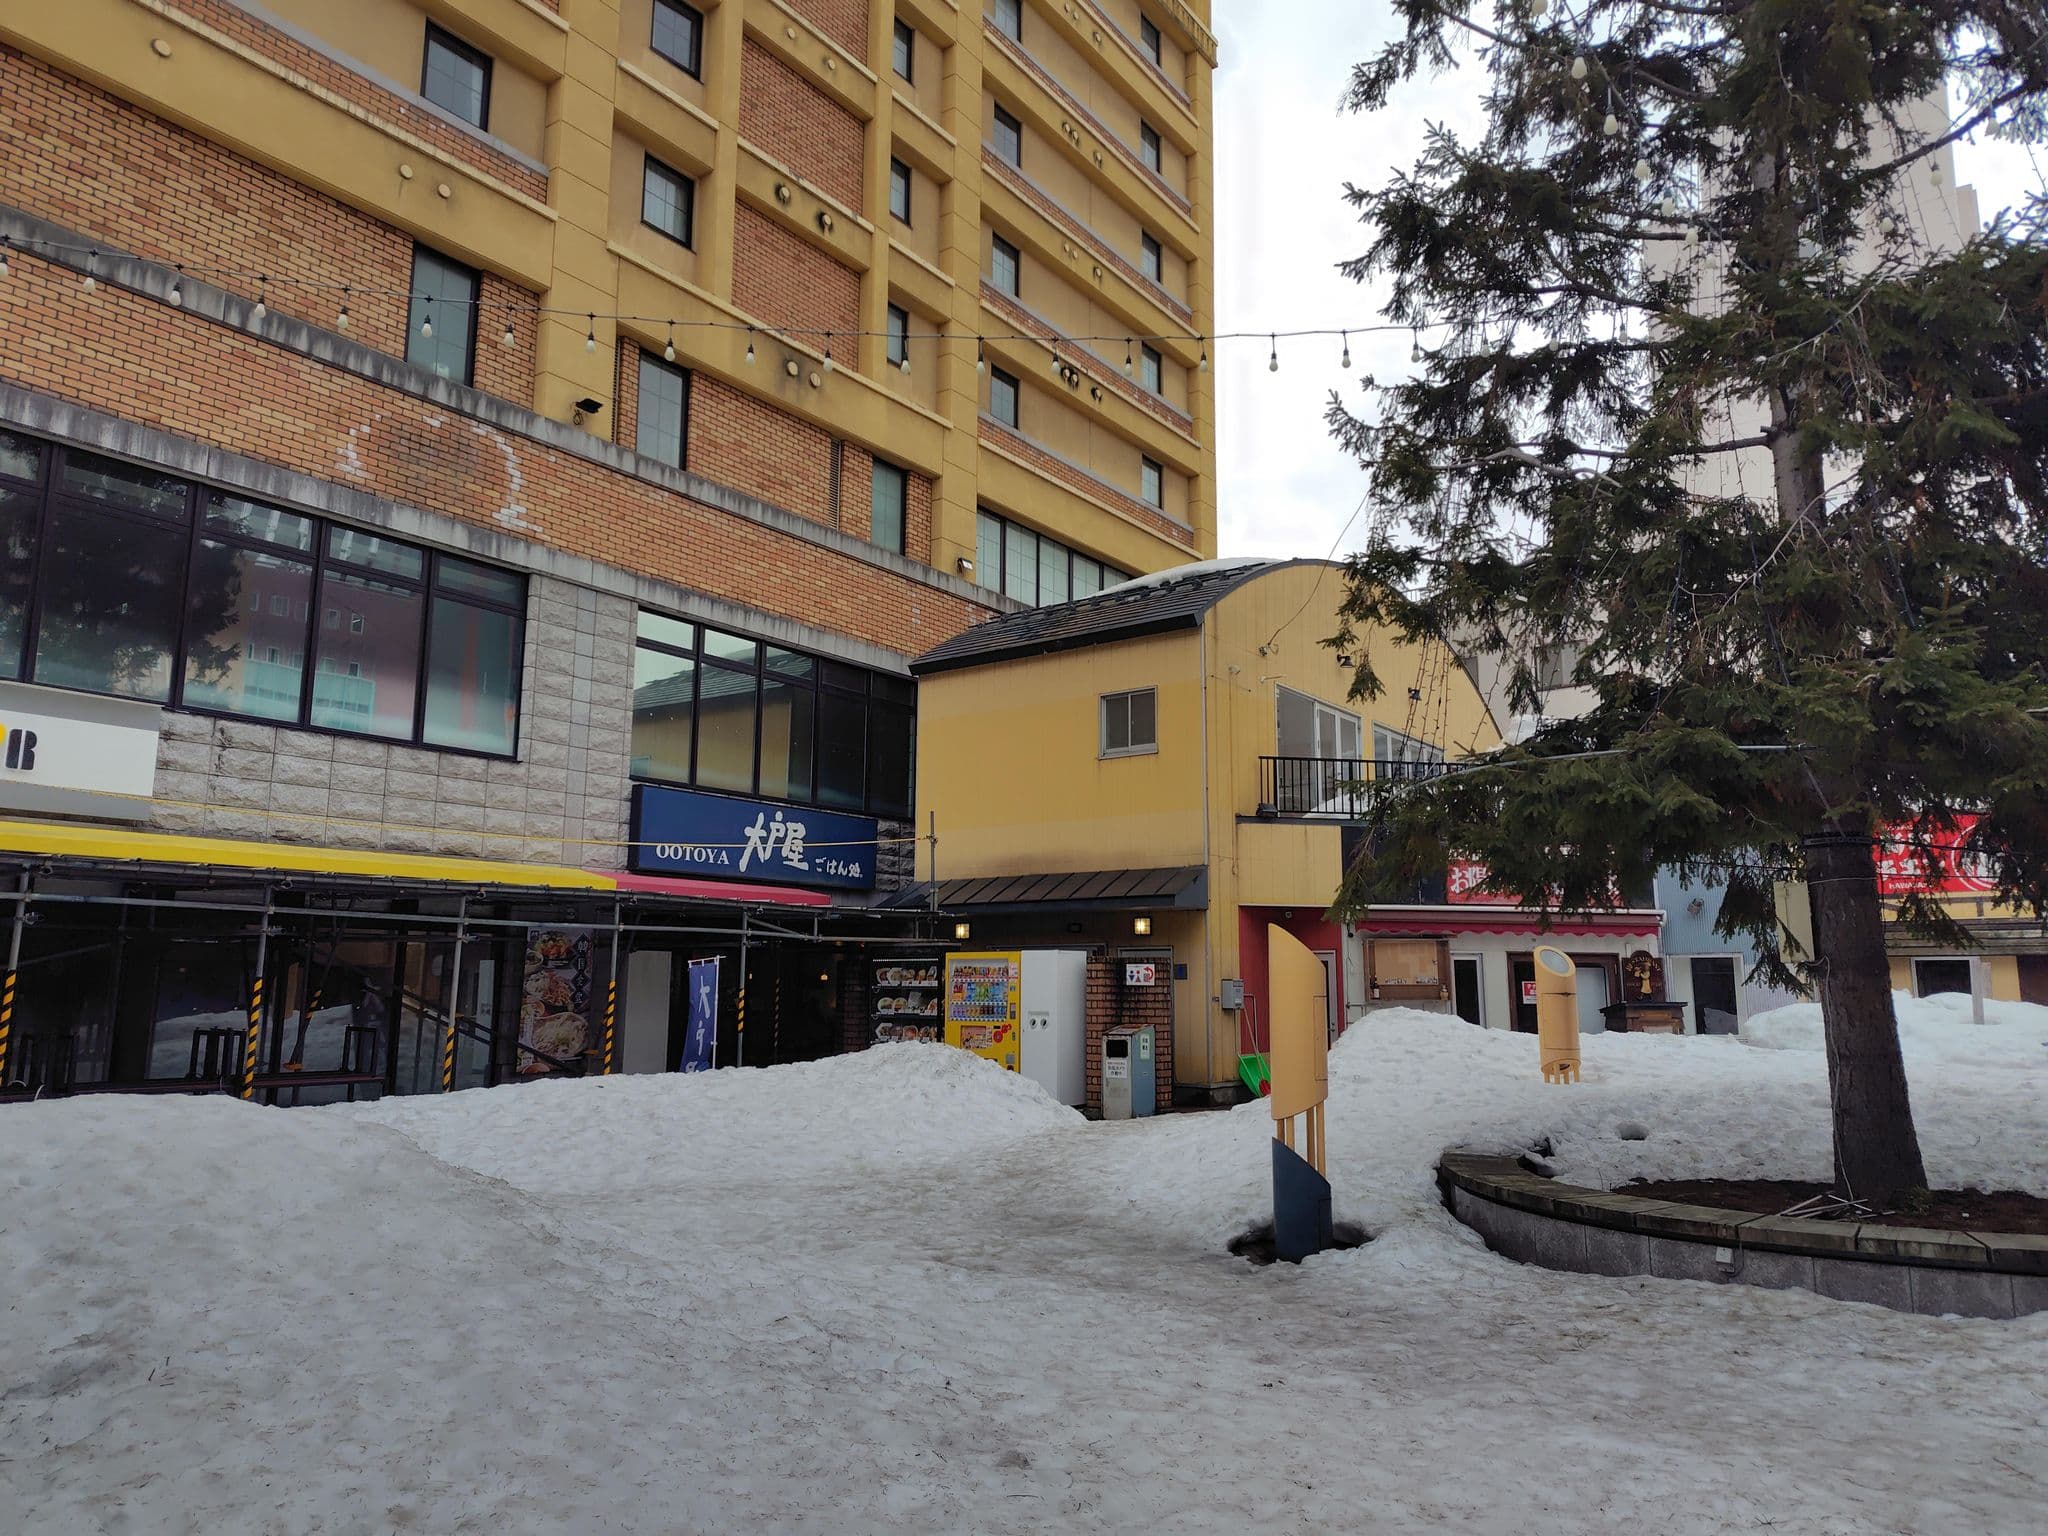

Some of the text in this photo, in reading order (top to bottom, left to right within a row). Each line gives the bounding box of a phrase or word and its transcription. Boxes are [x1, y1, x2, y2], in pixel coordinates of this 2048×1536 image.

[656, 843, 730, 865] OOTOYA
[739, 811, 809, 872] 大戸屋
